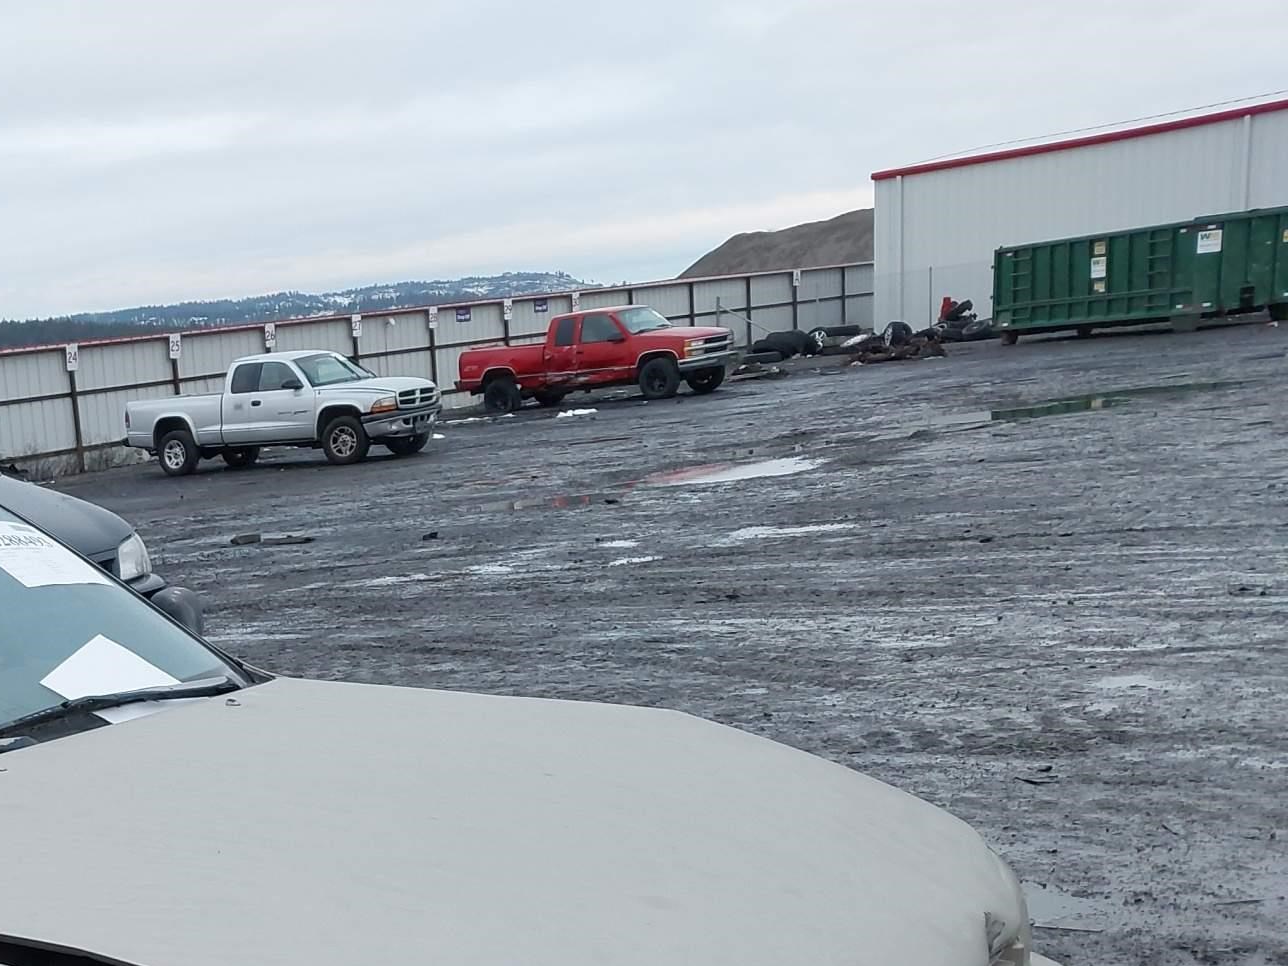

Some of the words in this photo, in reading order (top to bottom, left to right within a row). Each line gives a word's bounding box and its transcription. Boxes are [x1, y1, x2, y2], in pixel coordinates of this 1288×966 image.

[266, 330, 275, 341] 26
[170, 340, 180, 352] 25
[67, 351, 78, 363] 24
